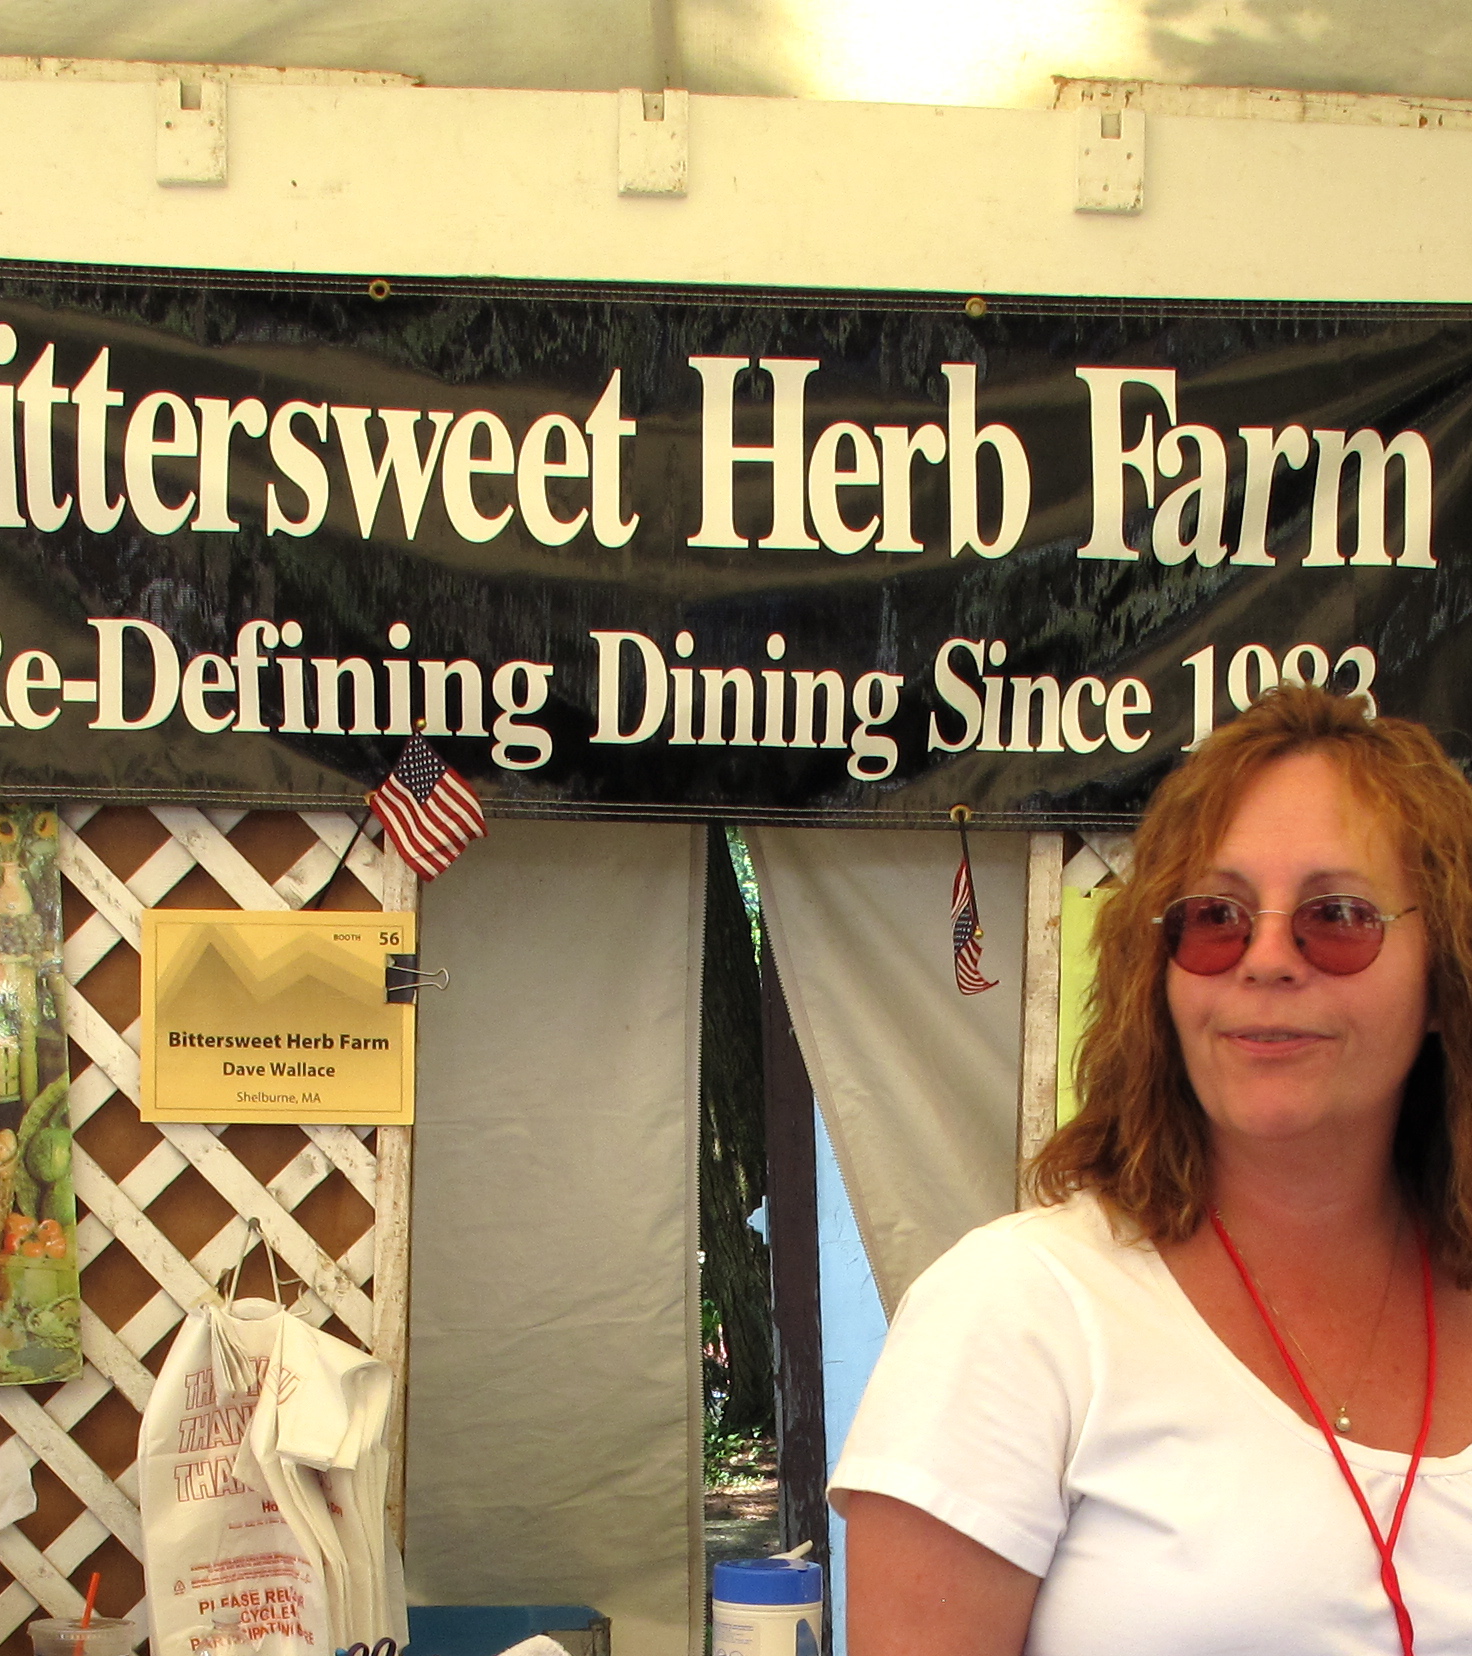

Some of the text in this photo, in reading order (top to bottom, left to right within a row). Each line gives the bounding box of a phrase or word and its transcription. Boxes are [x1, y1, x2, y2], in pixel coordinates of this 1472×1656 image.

[687, 354, 1030, 561] Herb
[1074, 365, 1437, 573] Farm
[590, 630, 895, 782] Dining
[928, 637, 1152, 753] Since
[333, 934, 361, 942] BOOTH
[379, 932, 400, 946] 56
[169, 1032, 389, 1050] Bittersweet Herb Farm
[223, 1062, 336, 1077] Dave Wallace
[236, 1092, 321, 1103] Shelburne, MA
[179, 1402, 257, 1453] THAN
